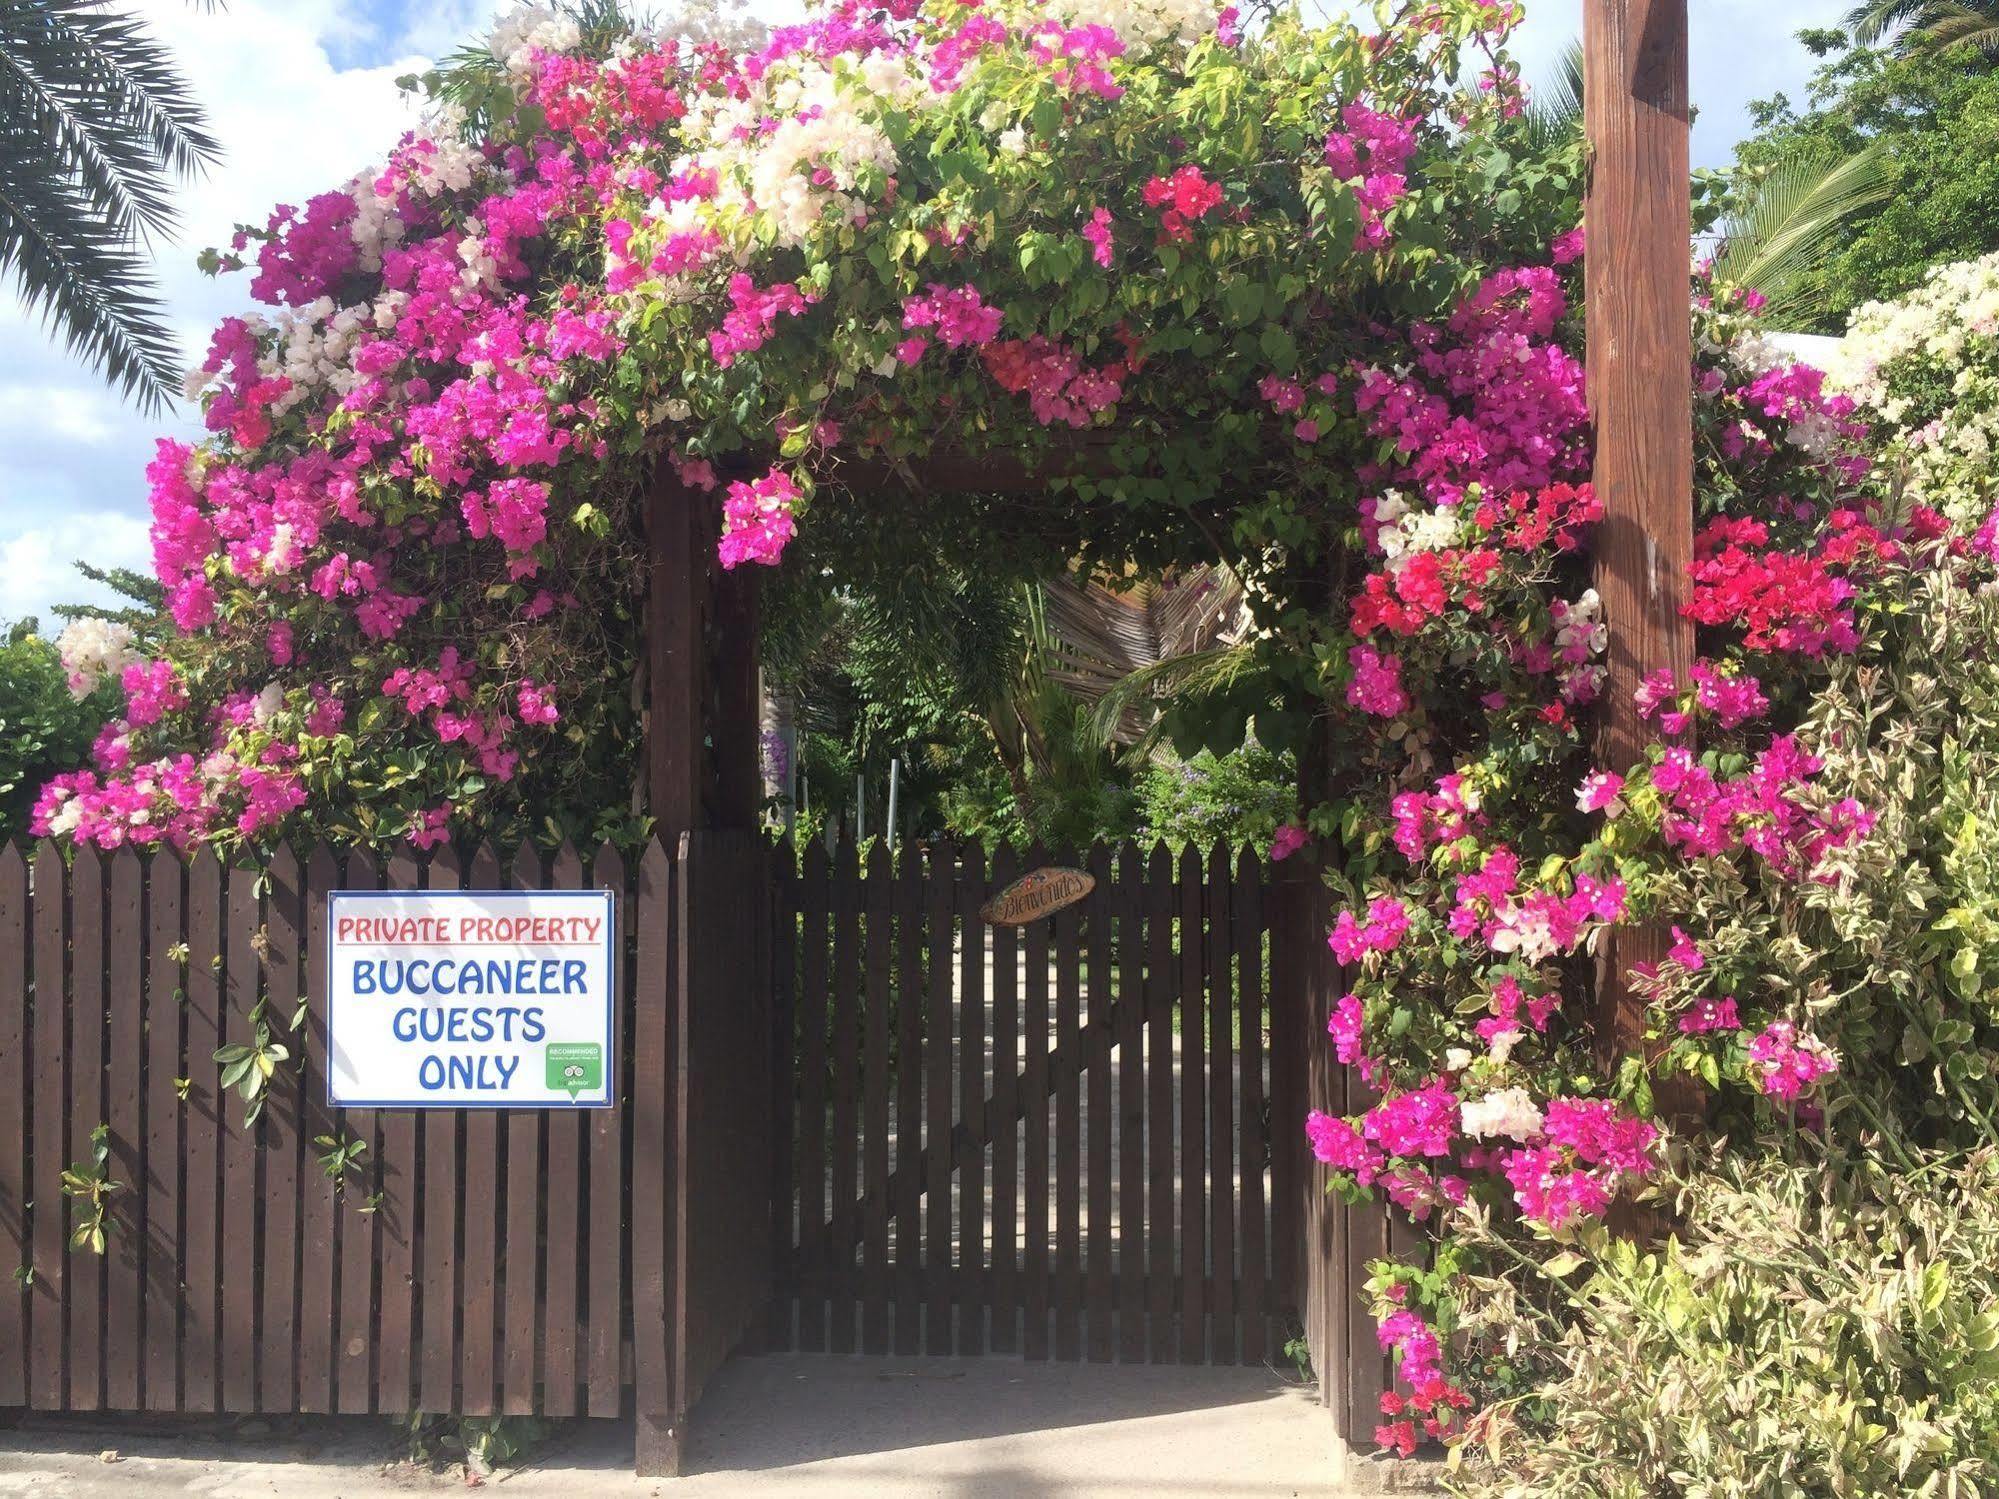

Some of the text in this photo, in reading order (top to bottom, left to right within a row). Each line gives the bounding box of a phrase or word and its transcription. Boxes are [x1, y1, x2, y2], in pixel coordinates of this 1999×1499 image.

[338, 917, 601, 941] PRIVATE PROPERTY
[353, 959, 588, 994] BUCCANEER
[393, 1007, 546, 1042] GUESTS
[419, 1055, 519, 1090] ONLY
